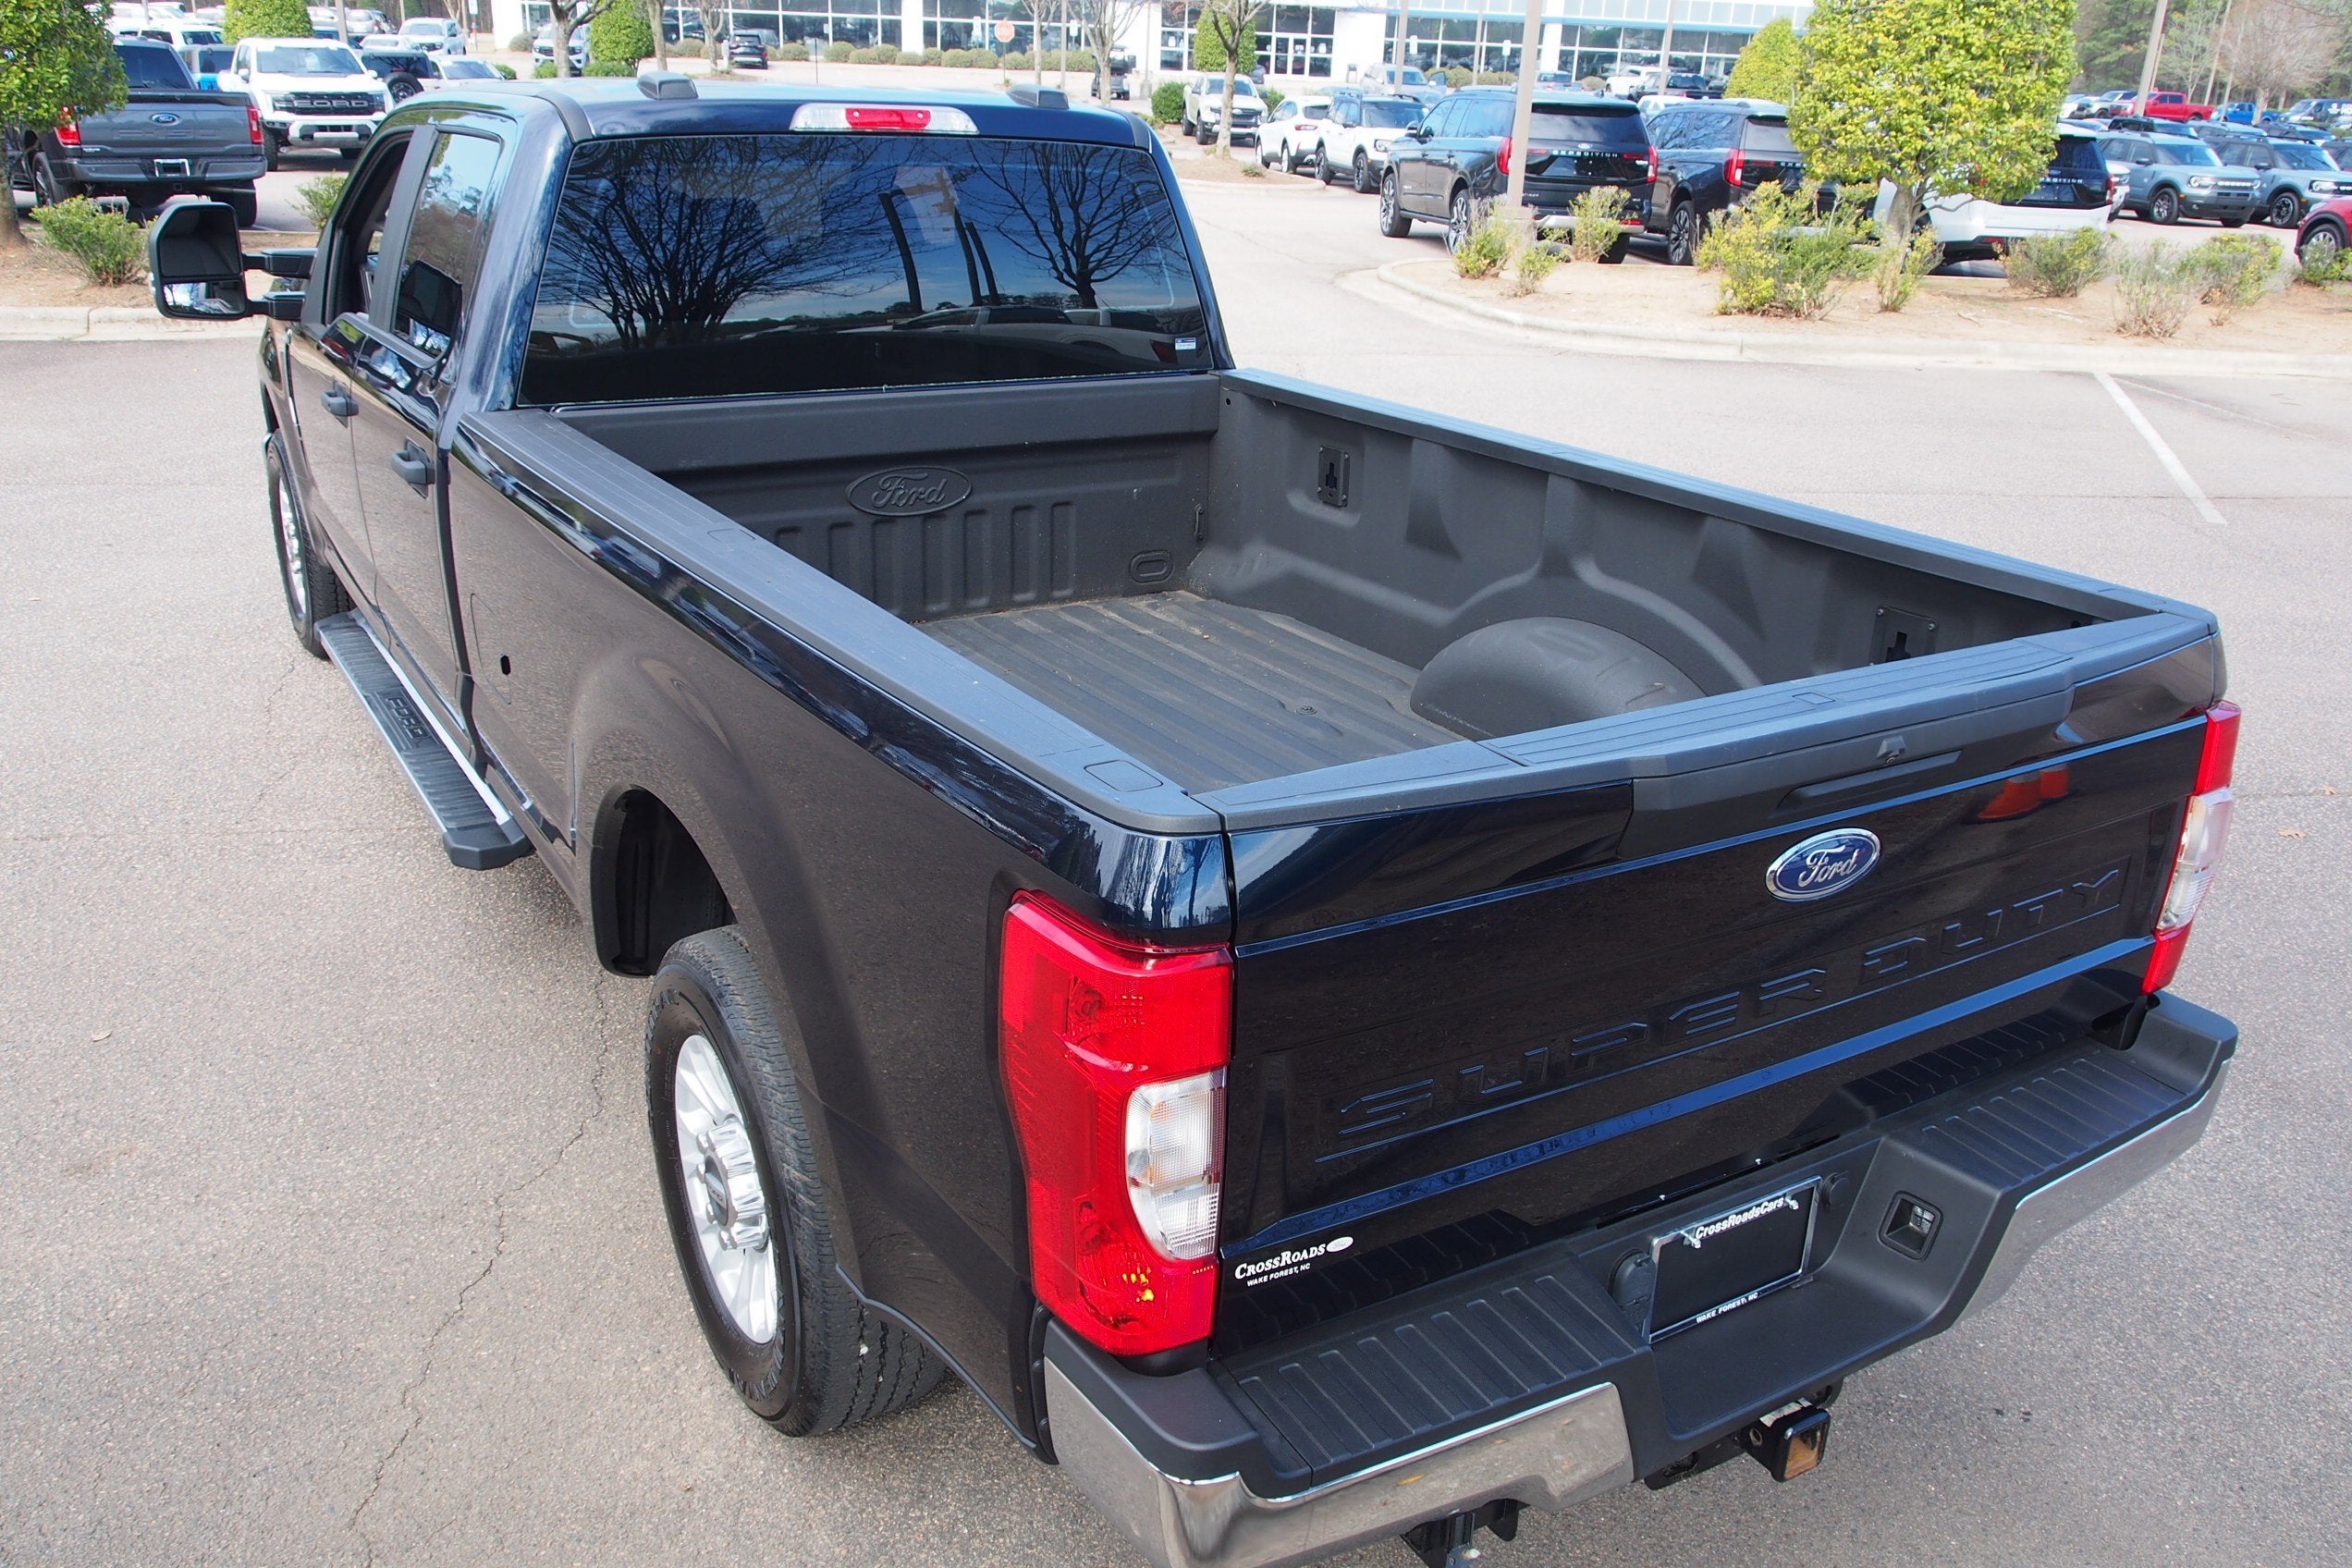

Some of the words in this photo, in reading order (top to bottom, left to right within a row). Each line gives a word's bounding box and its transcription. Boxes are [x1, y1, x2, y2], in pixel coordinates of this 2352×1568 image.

[293, 99, 369, 108] FORD
[872, 472, 949, 508] Ford
[385, 697, 428, 739] FORD
[1797, 844, 1860, 888] Ford
[1338, 967, 1828, 1138] SUPER
[1860, 869, 2119, 983] DUTY
[1695, 1196, 1785, 1240] CrossRoadsCars
[1246, 1275, 1269, 1287] WAKE
[1268, 1266, 1299, 1280] FOREST,
[1299, 1262, 1311, 1271] NC
[1696, 1309, 1717, 1323] WAKE
[1747, 1292, 1758, 1302] NC
